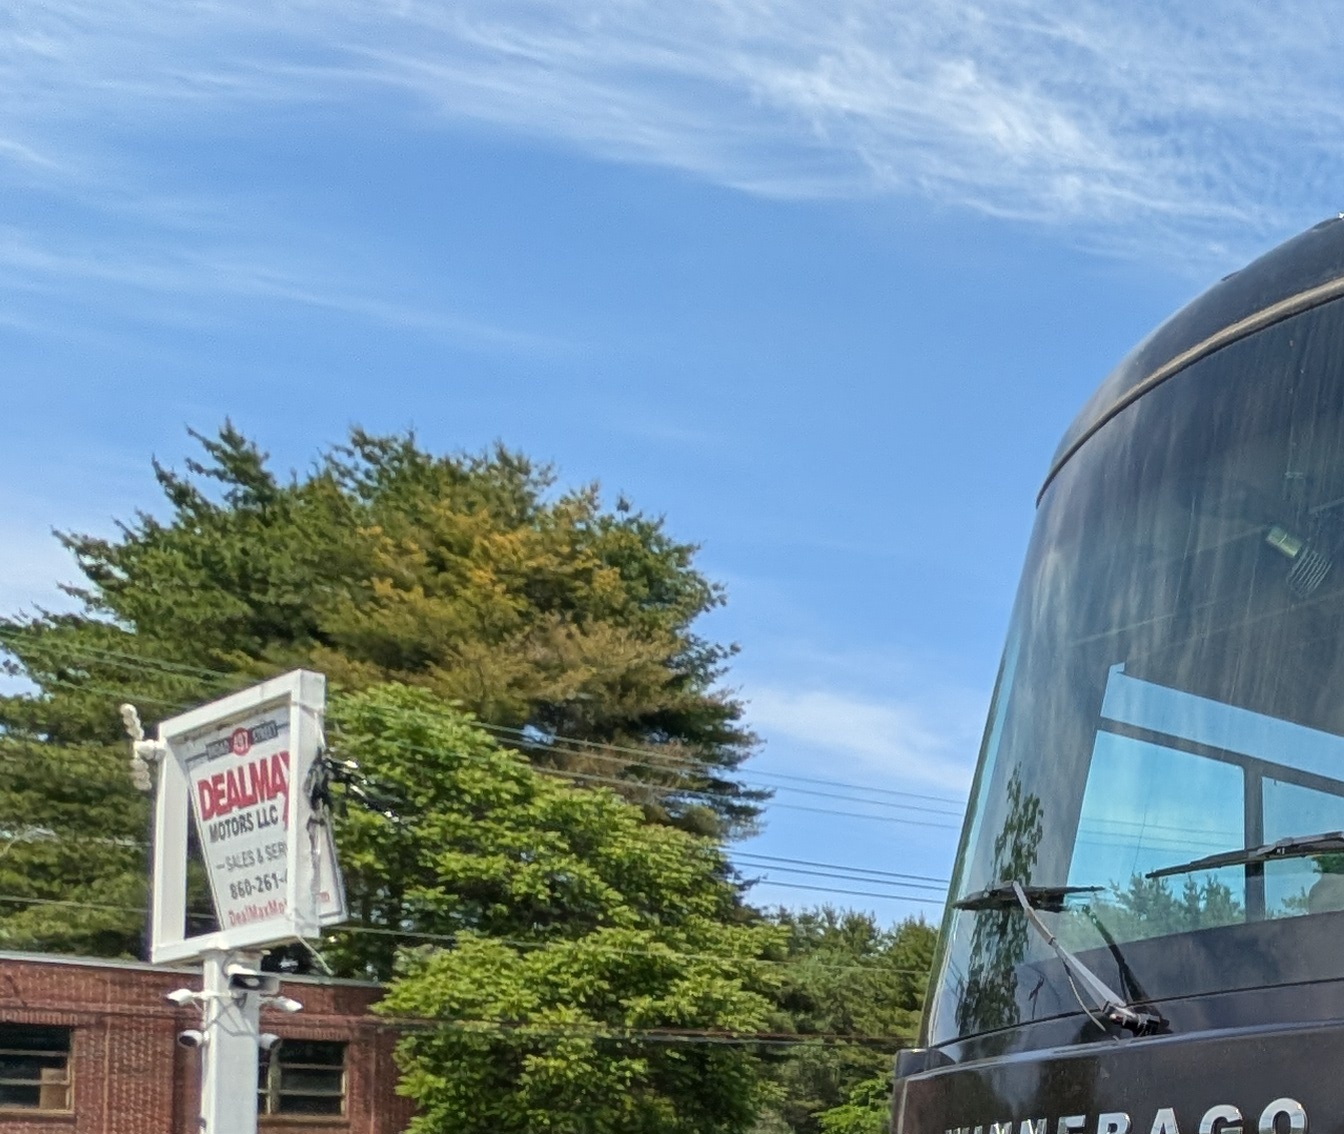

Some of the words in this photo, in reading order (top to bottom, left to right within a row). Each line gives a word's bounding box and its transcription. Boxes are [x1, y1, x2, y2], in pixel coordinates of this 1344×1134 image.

[208, 812, 255, 843] MOTORS
[256, 804, 279, 829] LLC
[229, 869, 288, 900] 860-261-
